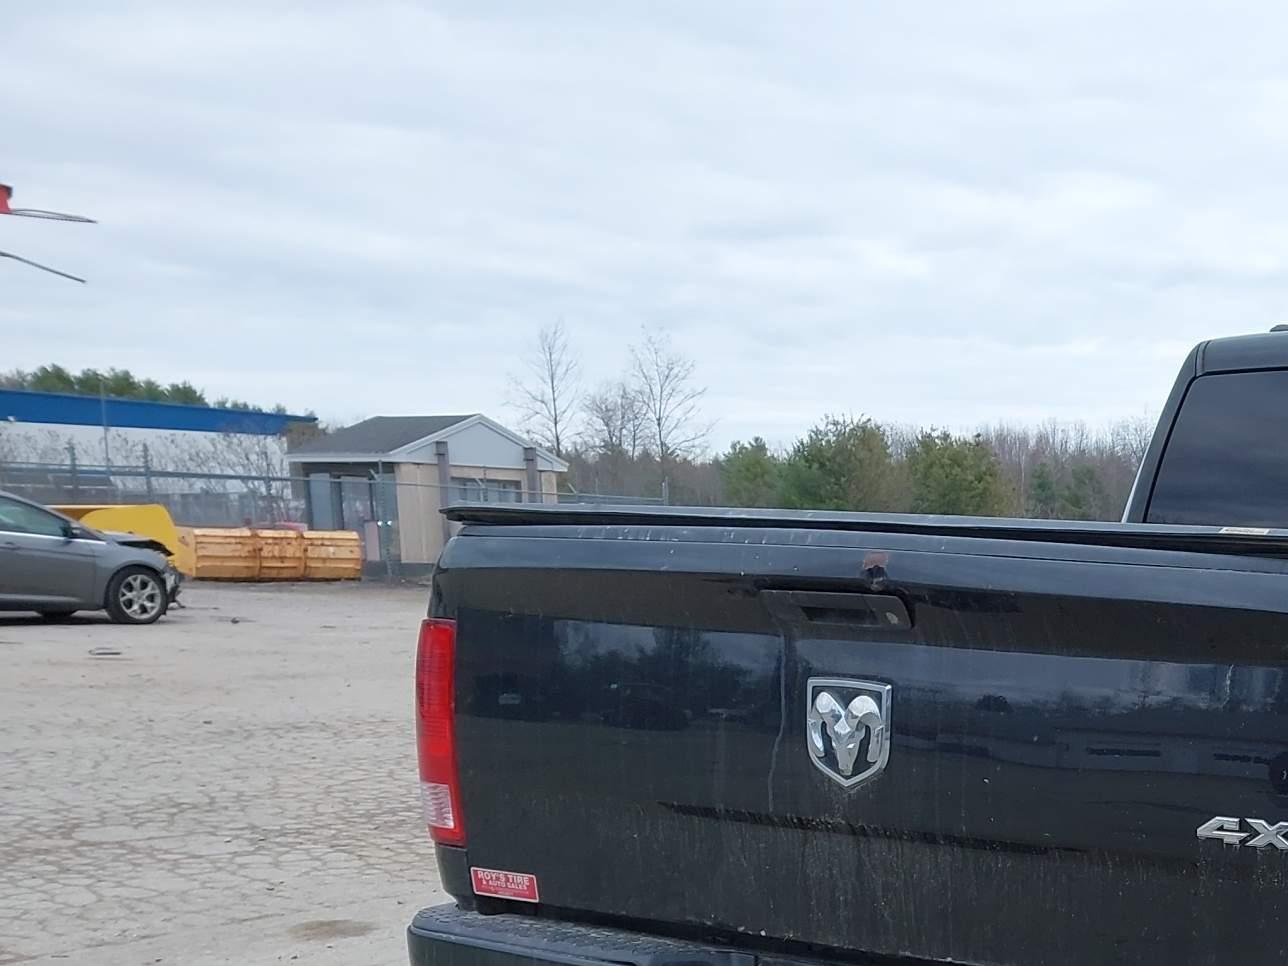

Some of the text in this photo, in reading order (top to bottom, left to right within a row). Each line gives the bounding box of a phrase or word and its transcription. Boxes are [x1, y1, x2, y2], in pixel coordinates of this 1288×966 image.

[477, 871, 529, 886] ROY'S TIRE
[507, 882, 527, 890] SALES
